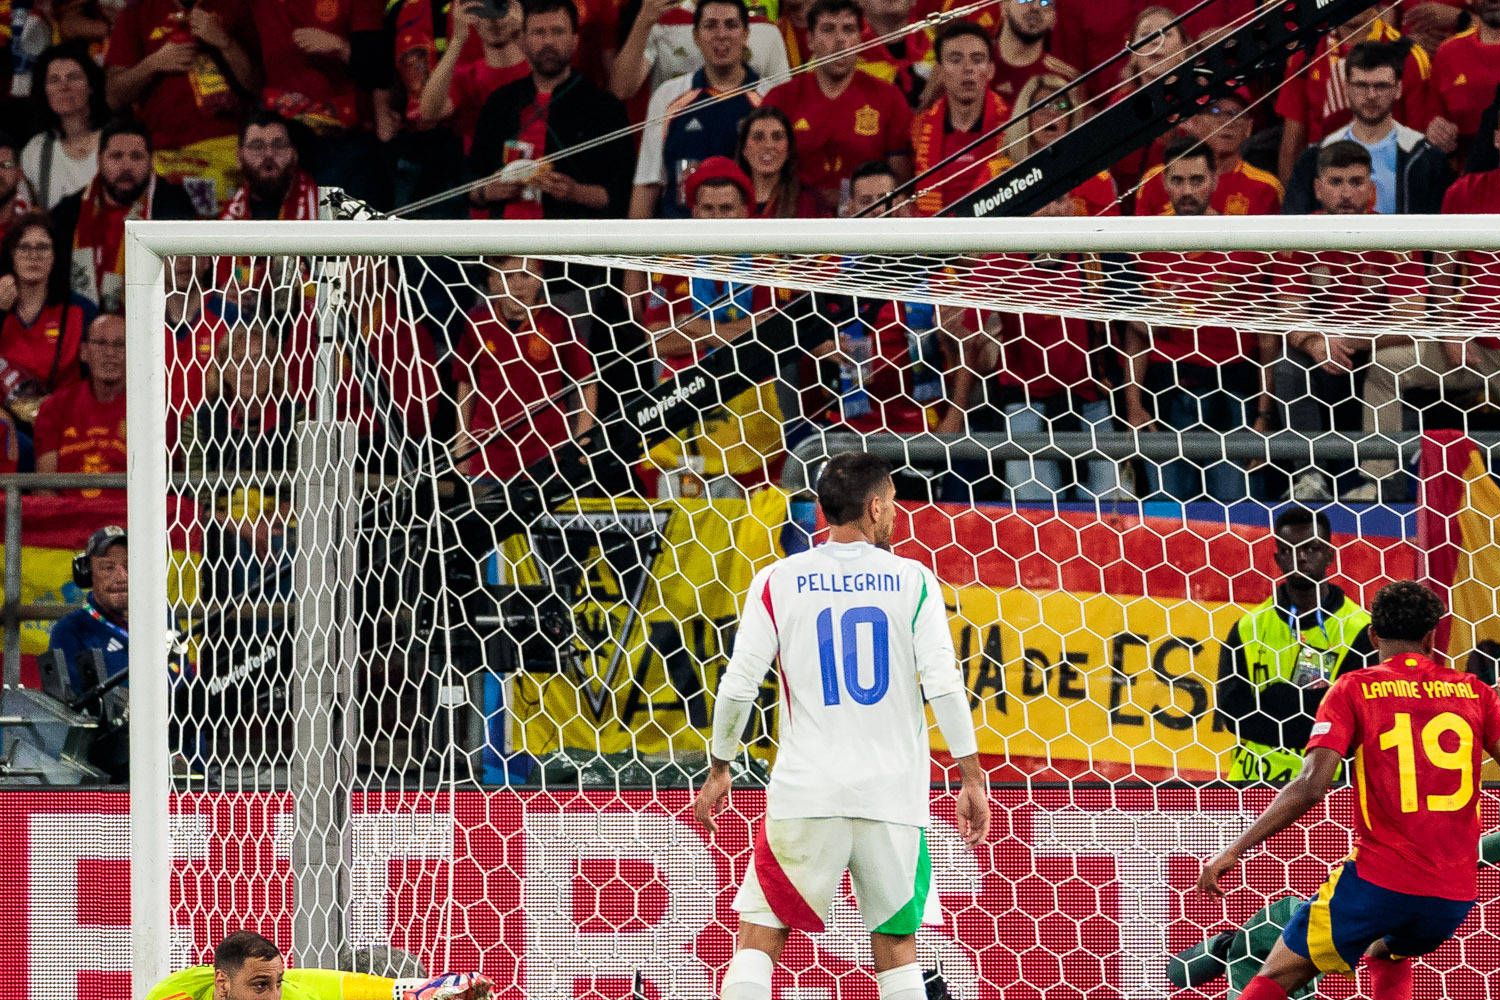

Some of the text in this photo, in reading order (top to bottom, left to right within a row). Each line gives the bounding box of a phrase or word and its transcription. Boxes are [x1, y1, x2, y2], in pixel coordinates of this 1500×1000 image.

[973, 168, 1042, 217] MovieTech
[797, 573, 901, 593] PELLEGRINI
[816, 606, 890, 707] 10
[1110, 631, 1227, 733] ES
[1361, 680, 1479, 700] LAMINE YAMAL
[1379, 712, 1474, 814] 19
